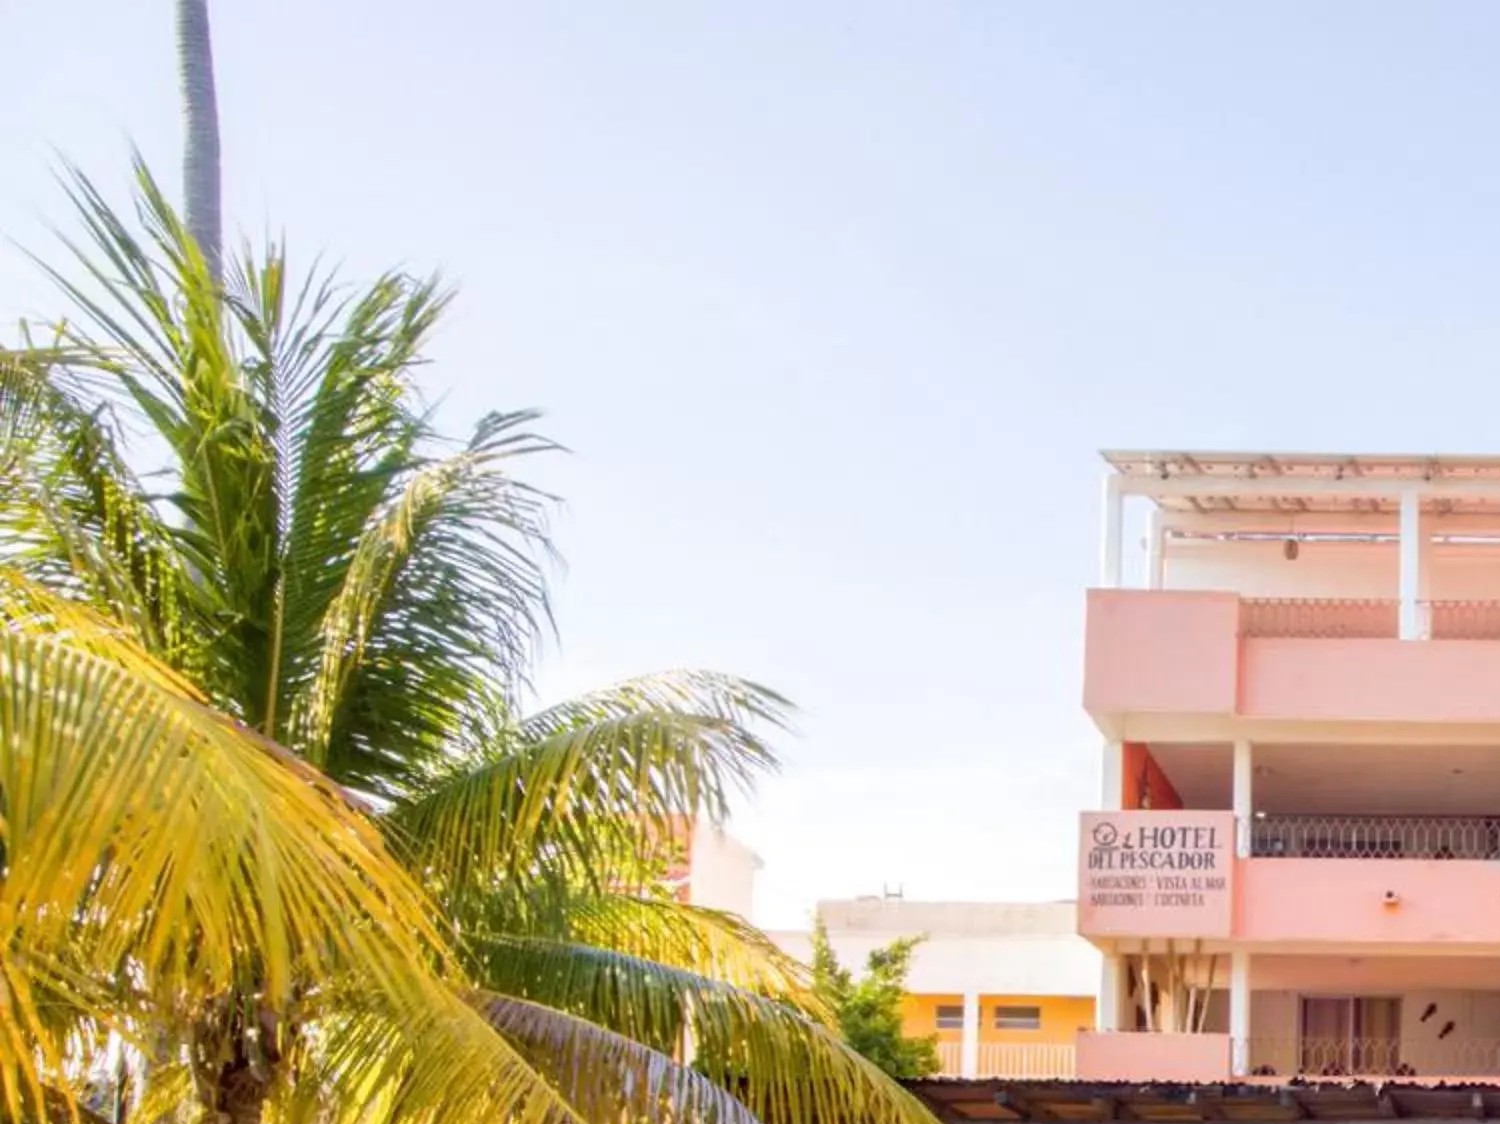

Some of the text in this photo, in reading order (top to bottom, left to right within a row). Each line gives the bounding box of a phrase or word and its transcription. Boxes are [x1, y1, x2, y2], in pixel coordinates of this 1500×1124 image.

[1138, 827, 1222, 849] HOTEL
[1088, 851, 1216, 870] DEL PESCADOR
[1156, 876, 1187, 890] VISTA
